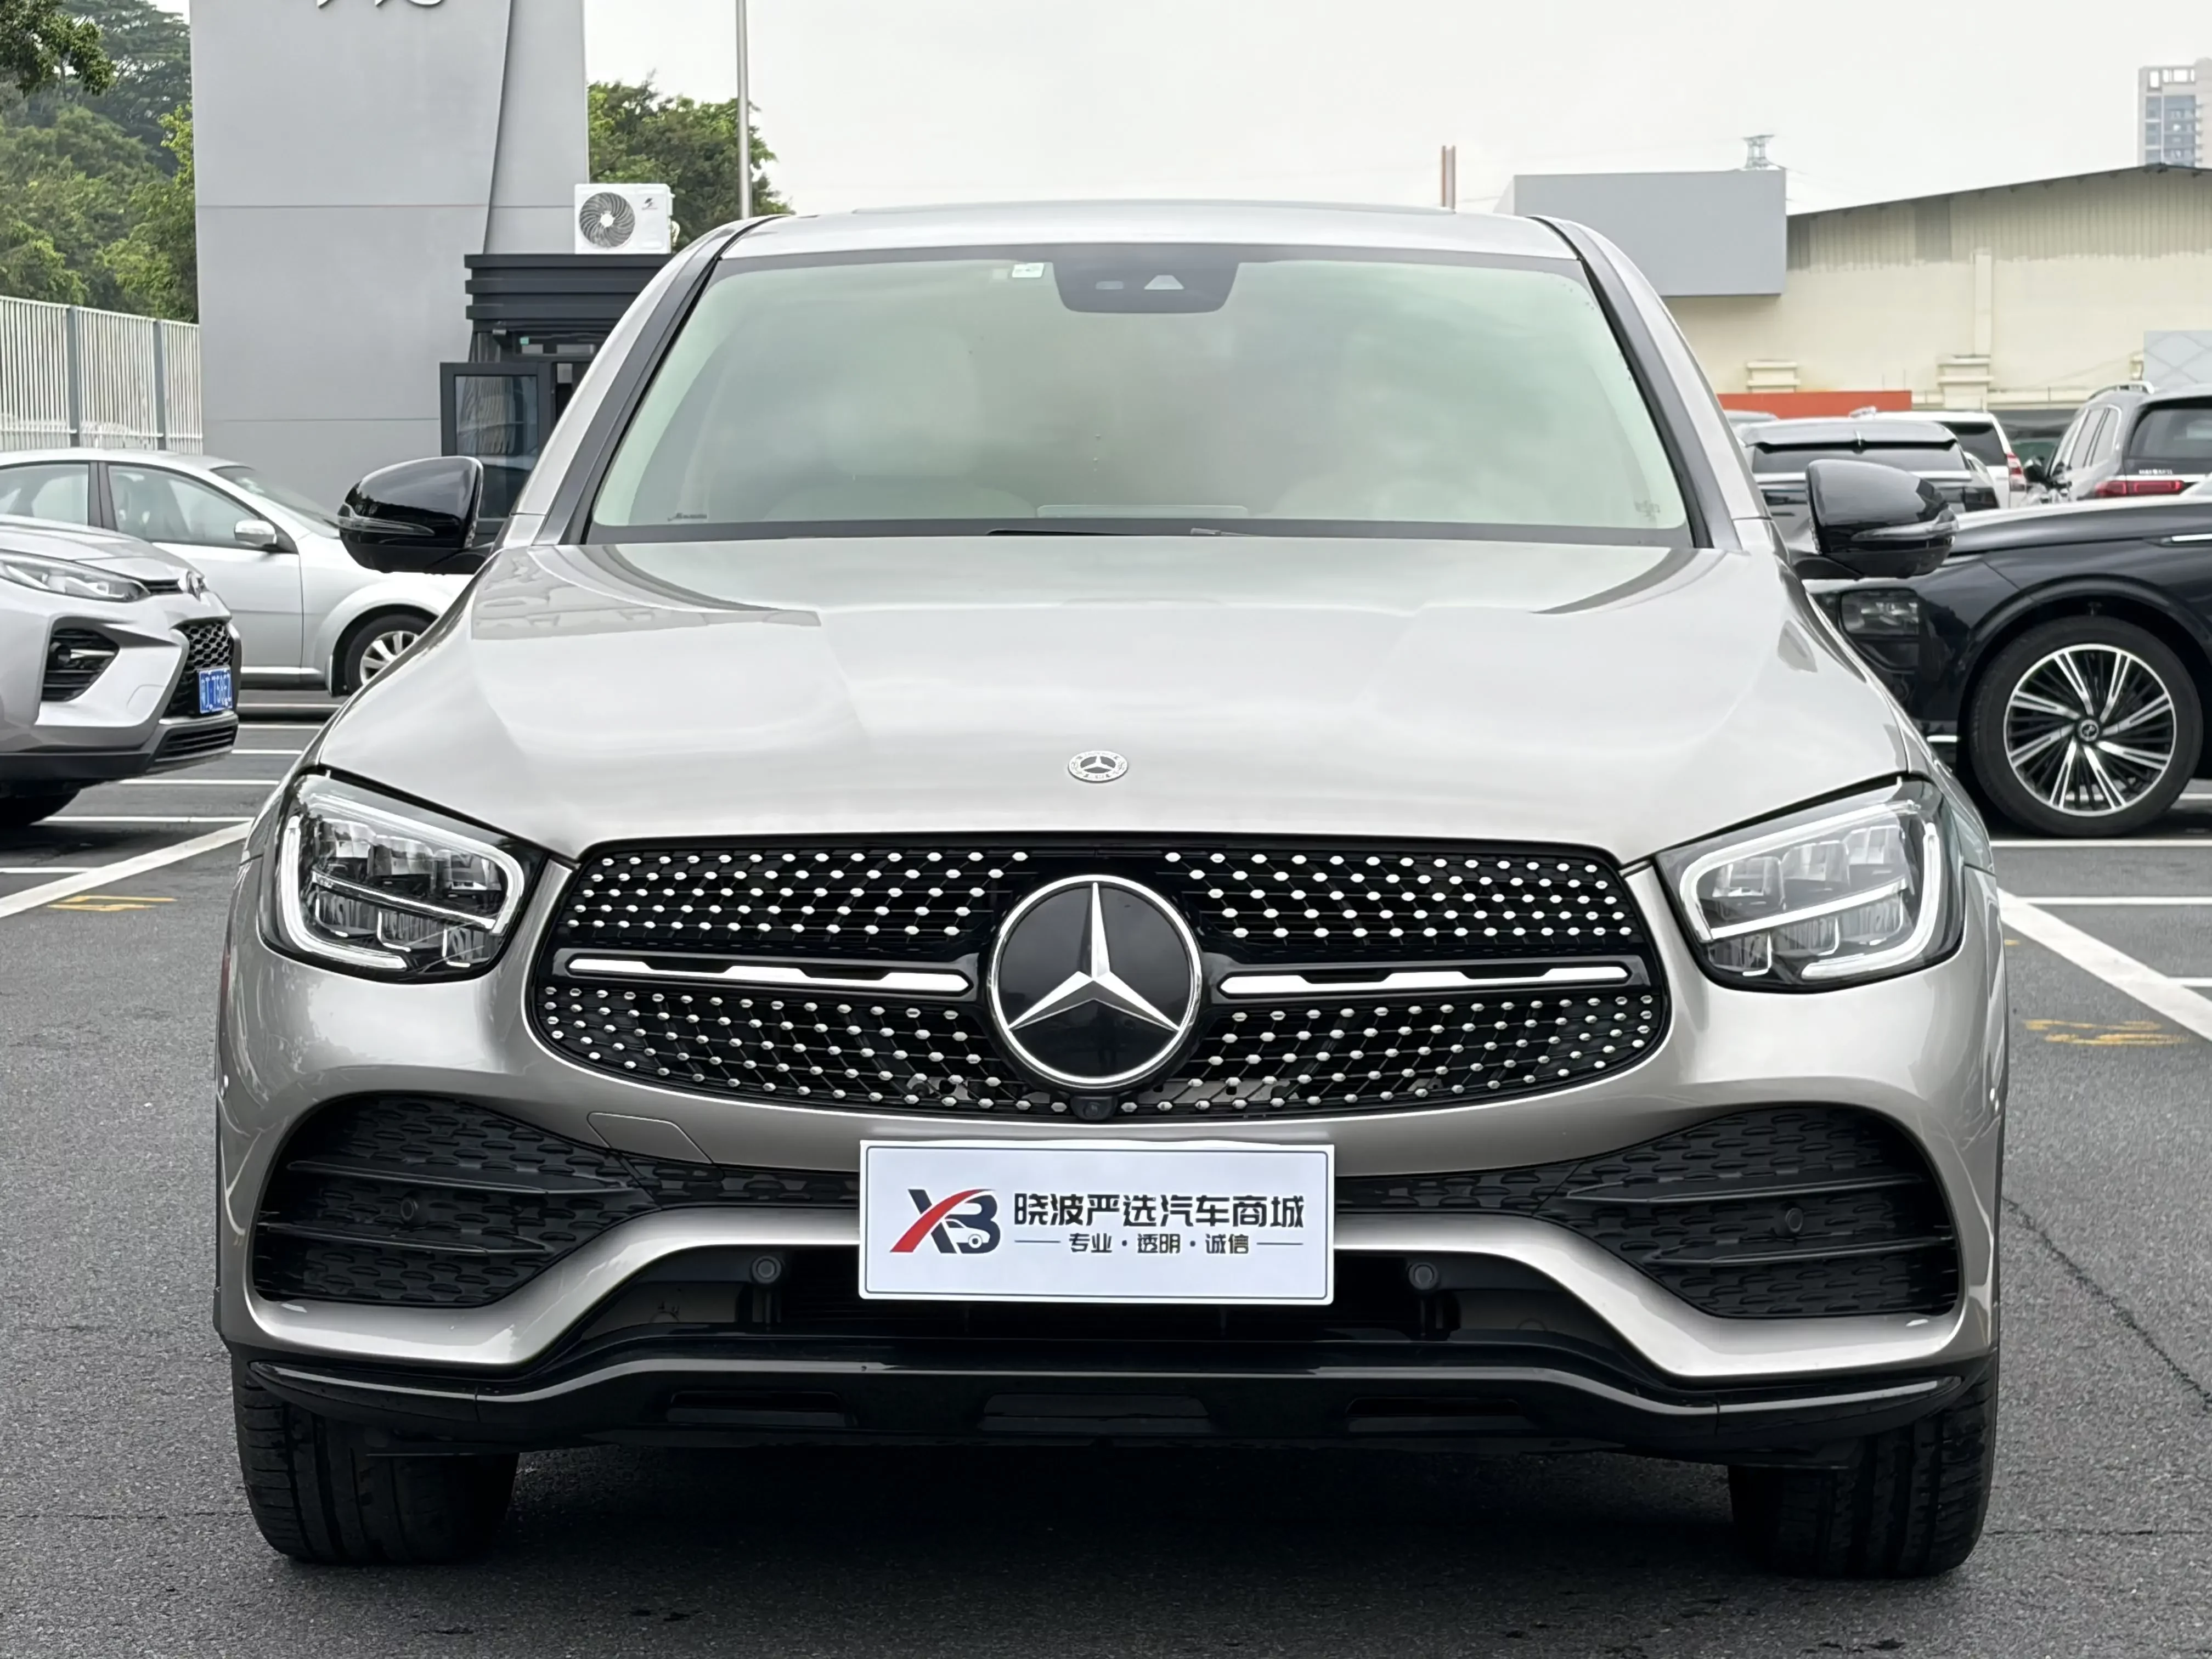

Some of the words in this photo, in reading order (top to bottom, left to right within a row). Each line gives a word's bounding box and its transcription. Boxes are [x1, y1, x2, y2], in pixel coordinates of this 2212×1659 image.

[1014, 1193, 1304, 1227] 晓波严选汽车商城
